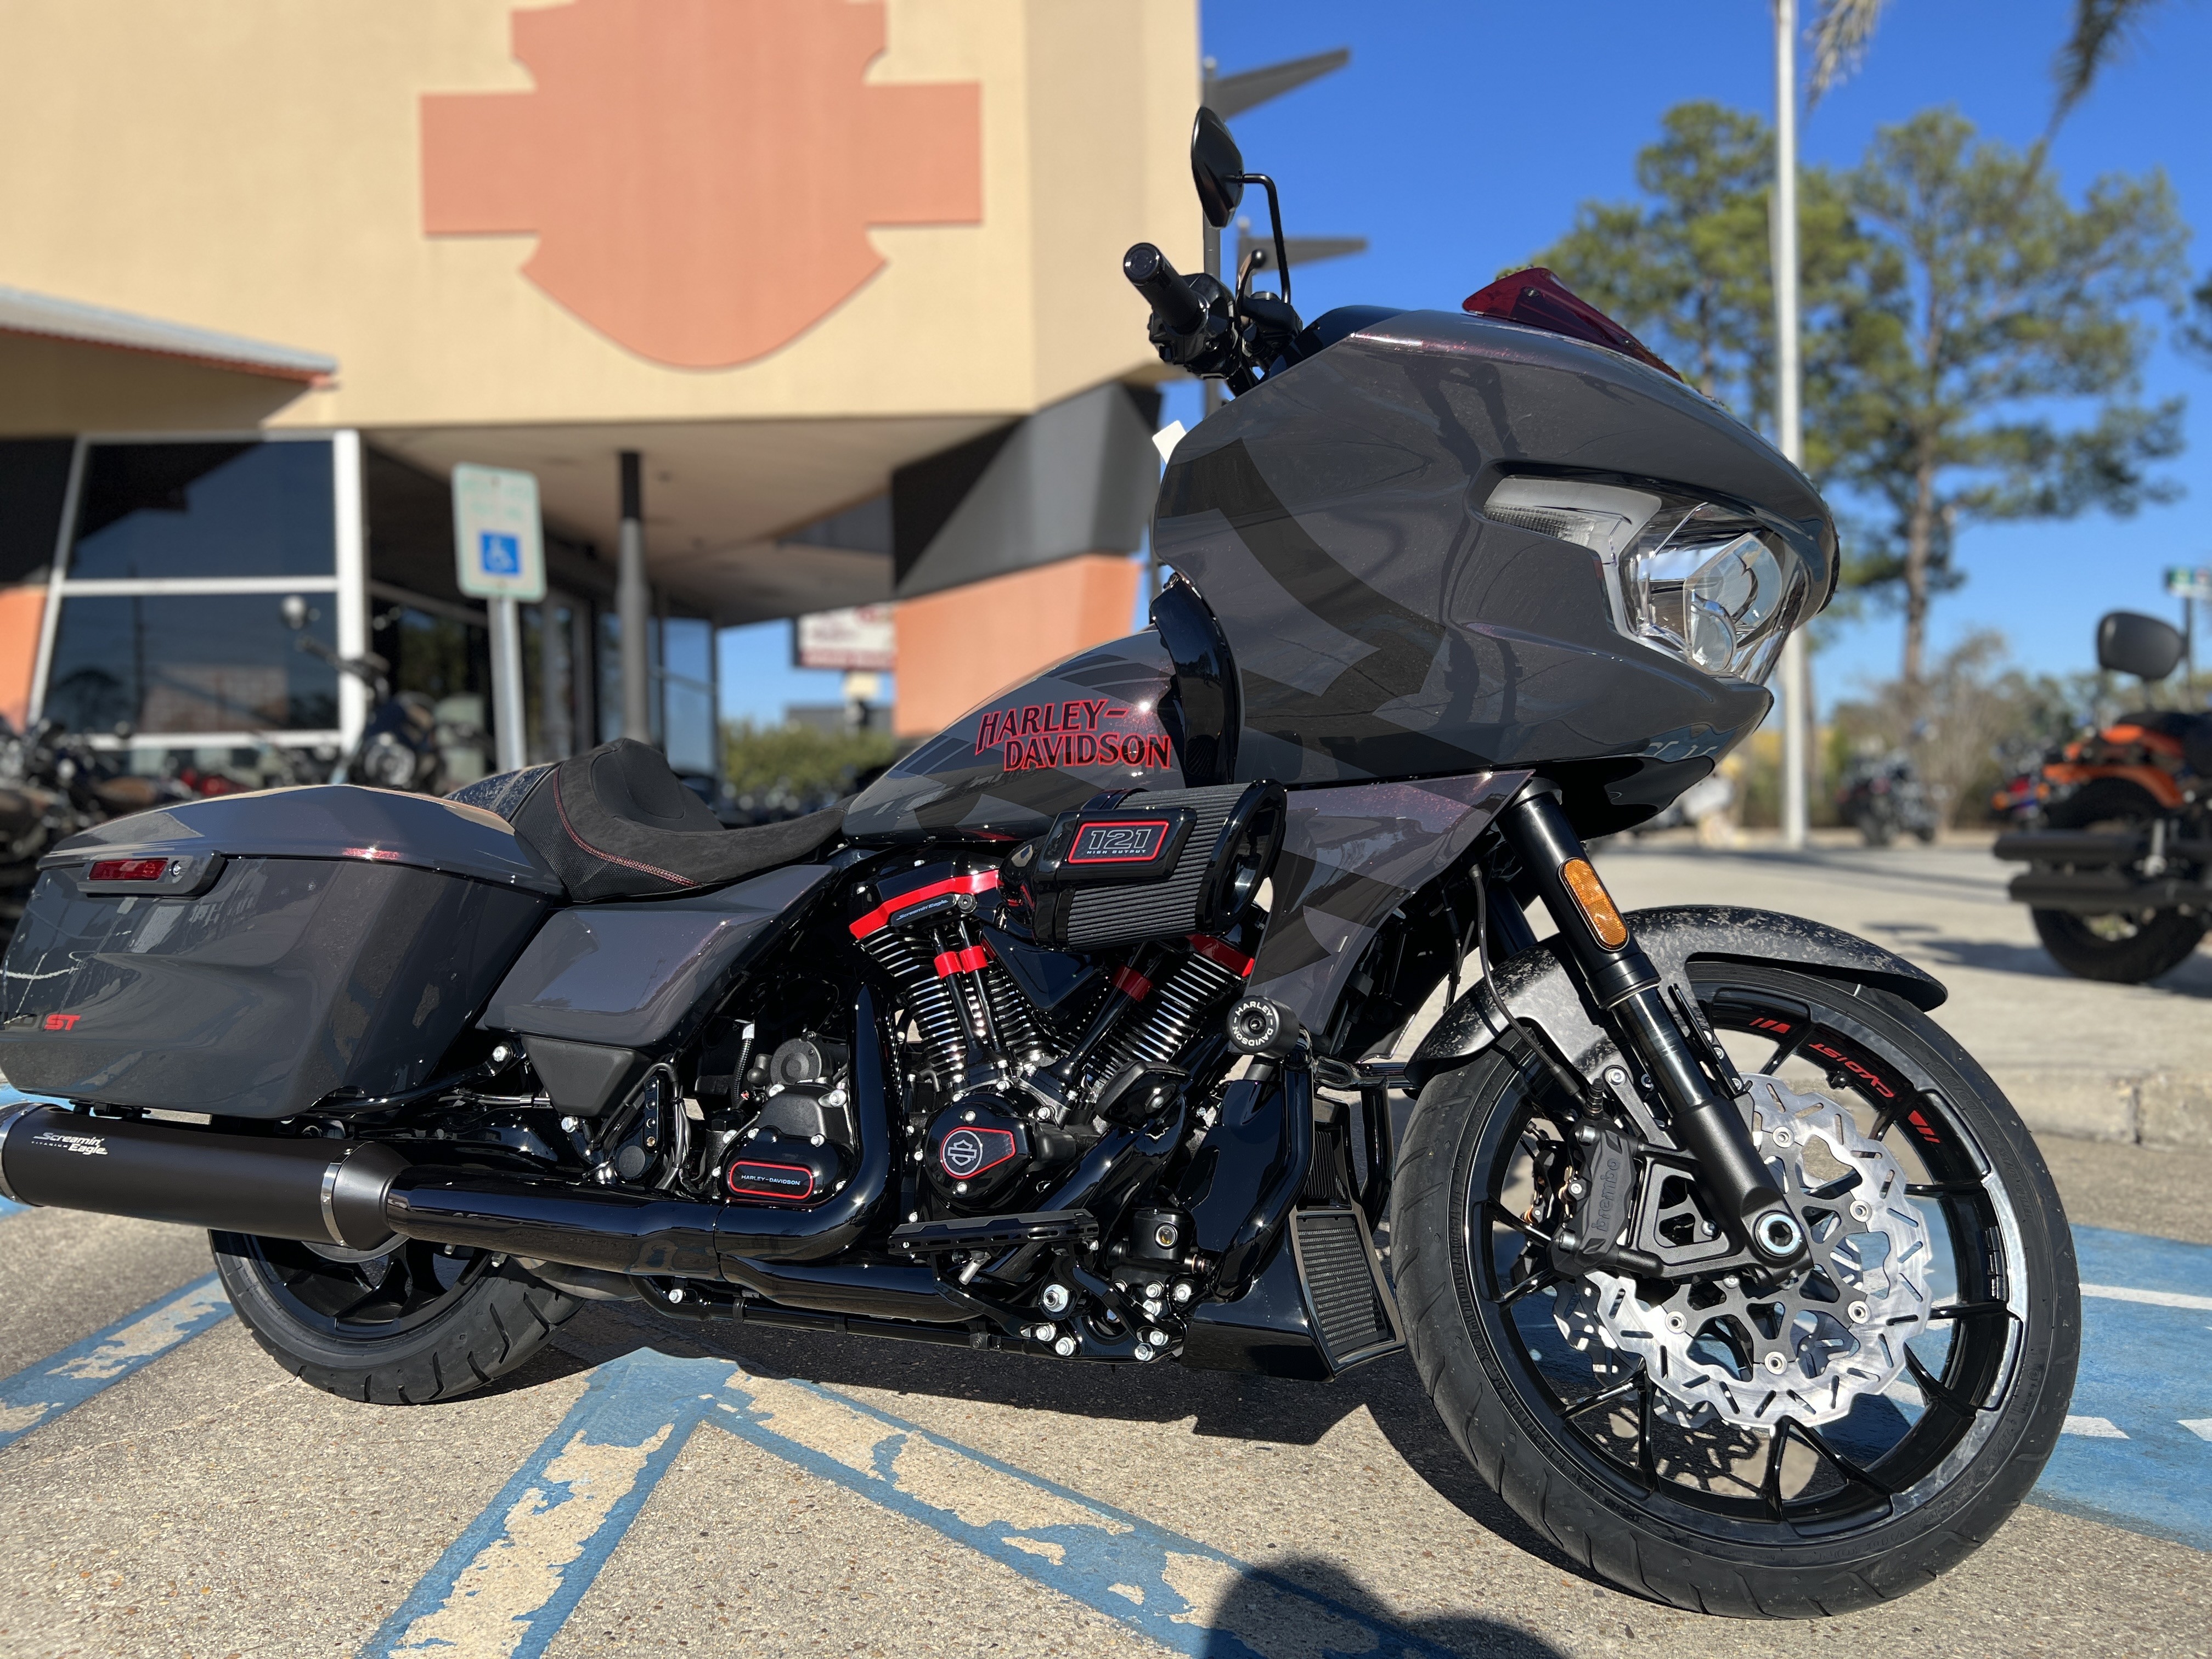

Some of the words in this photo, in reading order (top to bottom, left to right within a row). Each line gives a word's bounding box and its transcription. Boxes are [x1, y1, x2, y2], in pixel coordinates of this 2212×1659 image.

[974, 698, 1130, 755] HARLEY-
[1003, 732, 1171, 772] DAVIDSON
[1088, 829, 1152, 850] 121
[1234, 1001, 1273, 1017] HARLEY
[44, 1013, 81, 1031] ST
[1232, 1026, 1274, 1047] DAVIDSON
[33, 1132, 105, 1146] Screamin'
[67, 1143, 108, 1155] Eagle
[741, 1175, 802, 1186] HARLEY-DAVIDSON
[1591, 1158, 1620, 1232] brembo
